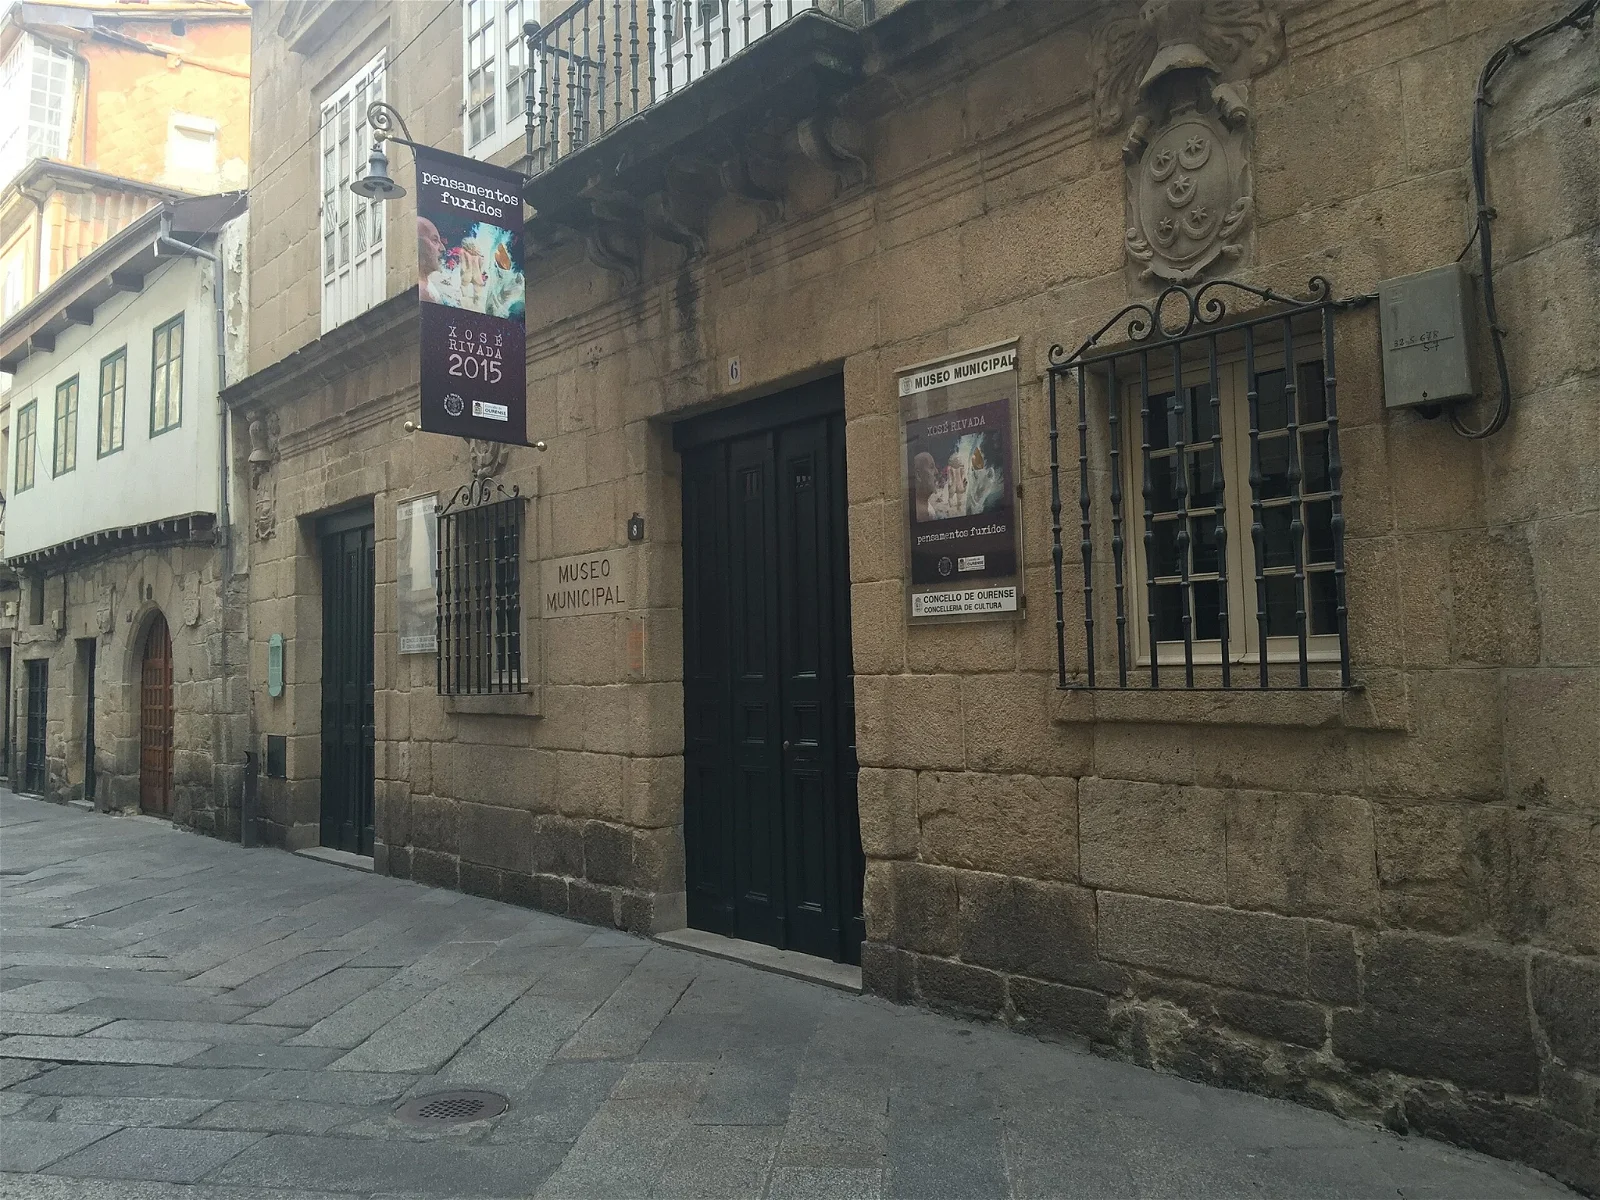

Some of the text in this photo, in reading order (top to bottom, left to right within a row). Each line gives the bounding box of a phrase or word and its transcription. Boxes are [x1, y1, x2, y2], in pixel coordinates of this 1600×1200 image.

[421, 171, 519, 206] pensamentos
[441, 191, 503, 218] fuxidos
[448, 325, 503, 347] XOSÉ
[448, 338, 503, 360] RIVADA
[448, 353, 502, 384] 2015
[730, 360, 738, 380] 6
[915, 354, 1014, 389] MUSEO MUNICIPAL
[927, 415, 986, 437] XOSÉ RIVADA
[917, 524, 1007, 545] pensamentos fuxidos
[558, 558, 611, 584] MUSEO
[546, 585, 625, 612] MUNICIPAL
[923, 589, 1014, 604] CONCELLO DE OURENSE
[924, 601, 1003, 614] CONCELLERIA DE CULTURA
